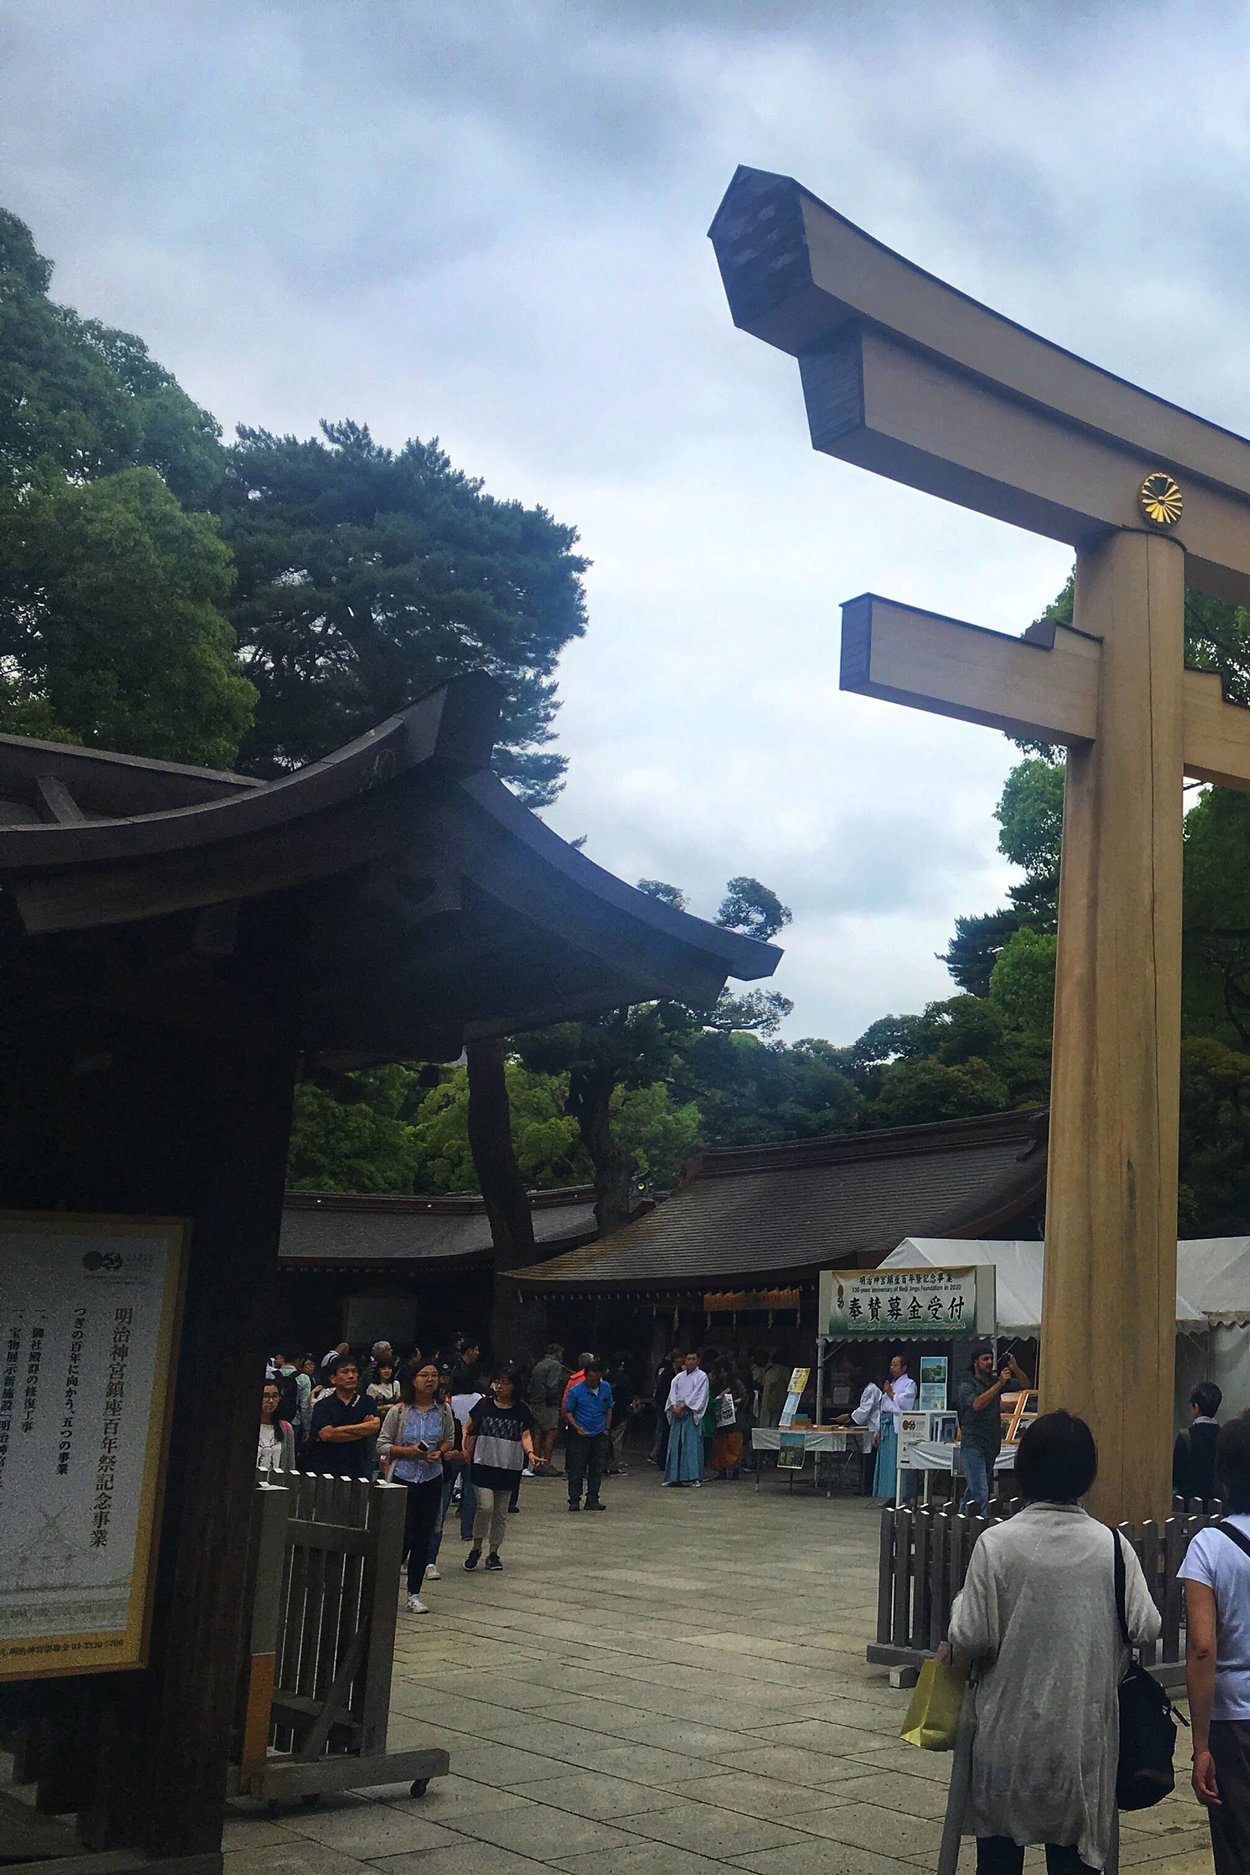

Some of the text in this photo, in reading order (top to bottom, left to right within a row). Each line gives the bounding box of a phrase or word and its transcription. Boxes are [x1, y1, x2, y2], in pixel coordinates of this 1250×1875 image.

[56, 1307, 87, 1475] つぎの百年に向かう、五つの事業
[848, 1295, 965, 1322] 奉賛募金受付
[90, 1306, 133, 1547] 明治神宮鎮座百年祭記念事業
